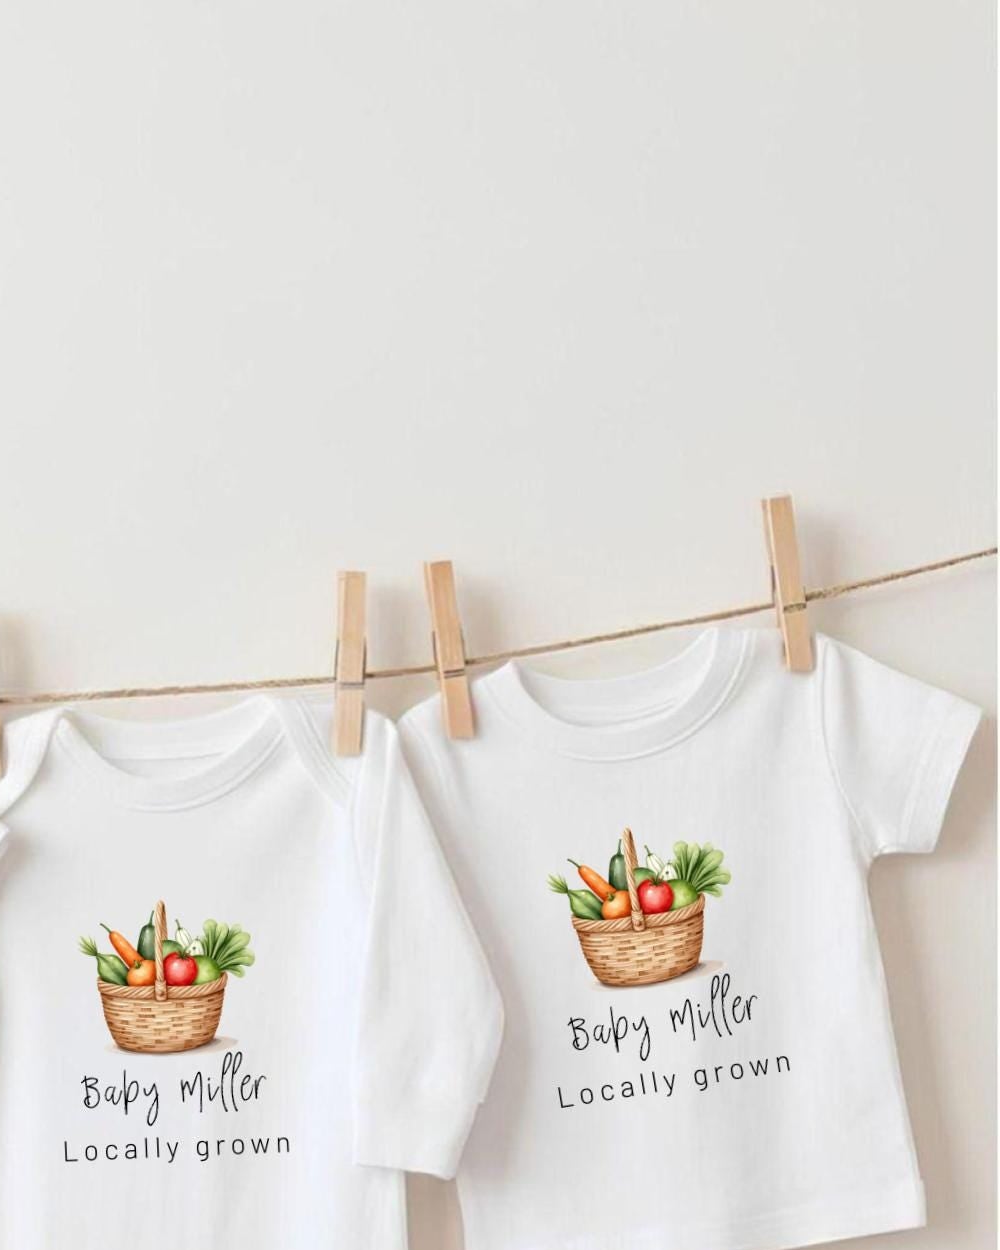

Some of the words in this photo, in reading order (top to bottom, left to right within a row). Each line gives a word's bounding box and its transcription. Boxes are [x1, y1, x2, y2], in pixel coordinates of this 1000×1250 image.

[567, 1006, 651, 1062] Baby
[669, 973, 758, 1042] Miller
[80, 1069, 160, 1127] Baby
[180, 1051, 267, 1113] Miller
[557, 1070, 676, 1109] Locally
[693, 1055, 791, 1092] grown
[64, 1136, 179, 1164] Locally
[196, 1136, 290, 1162] grown
